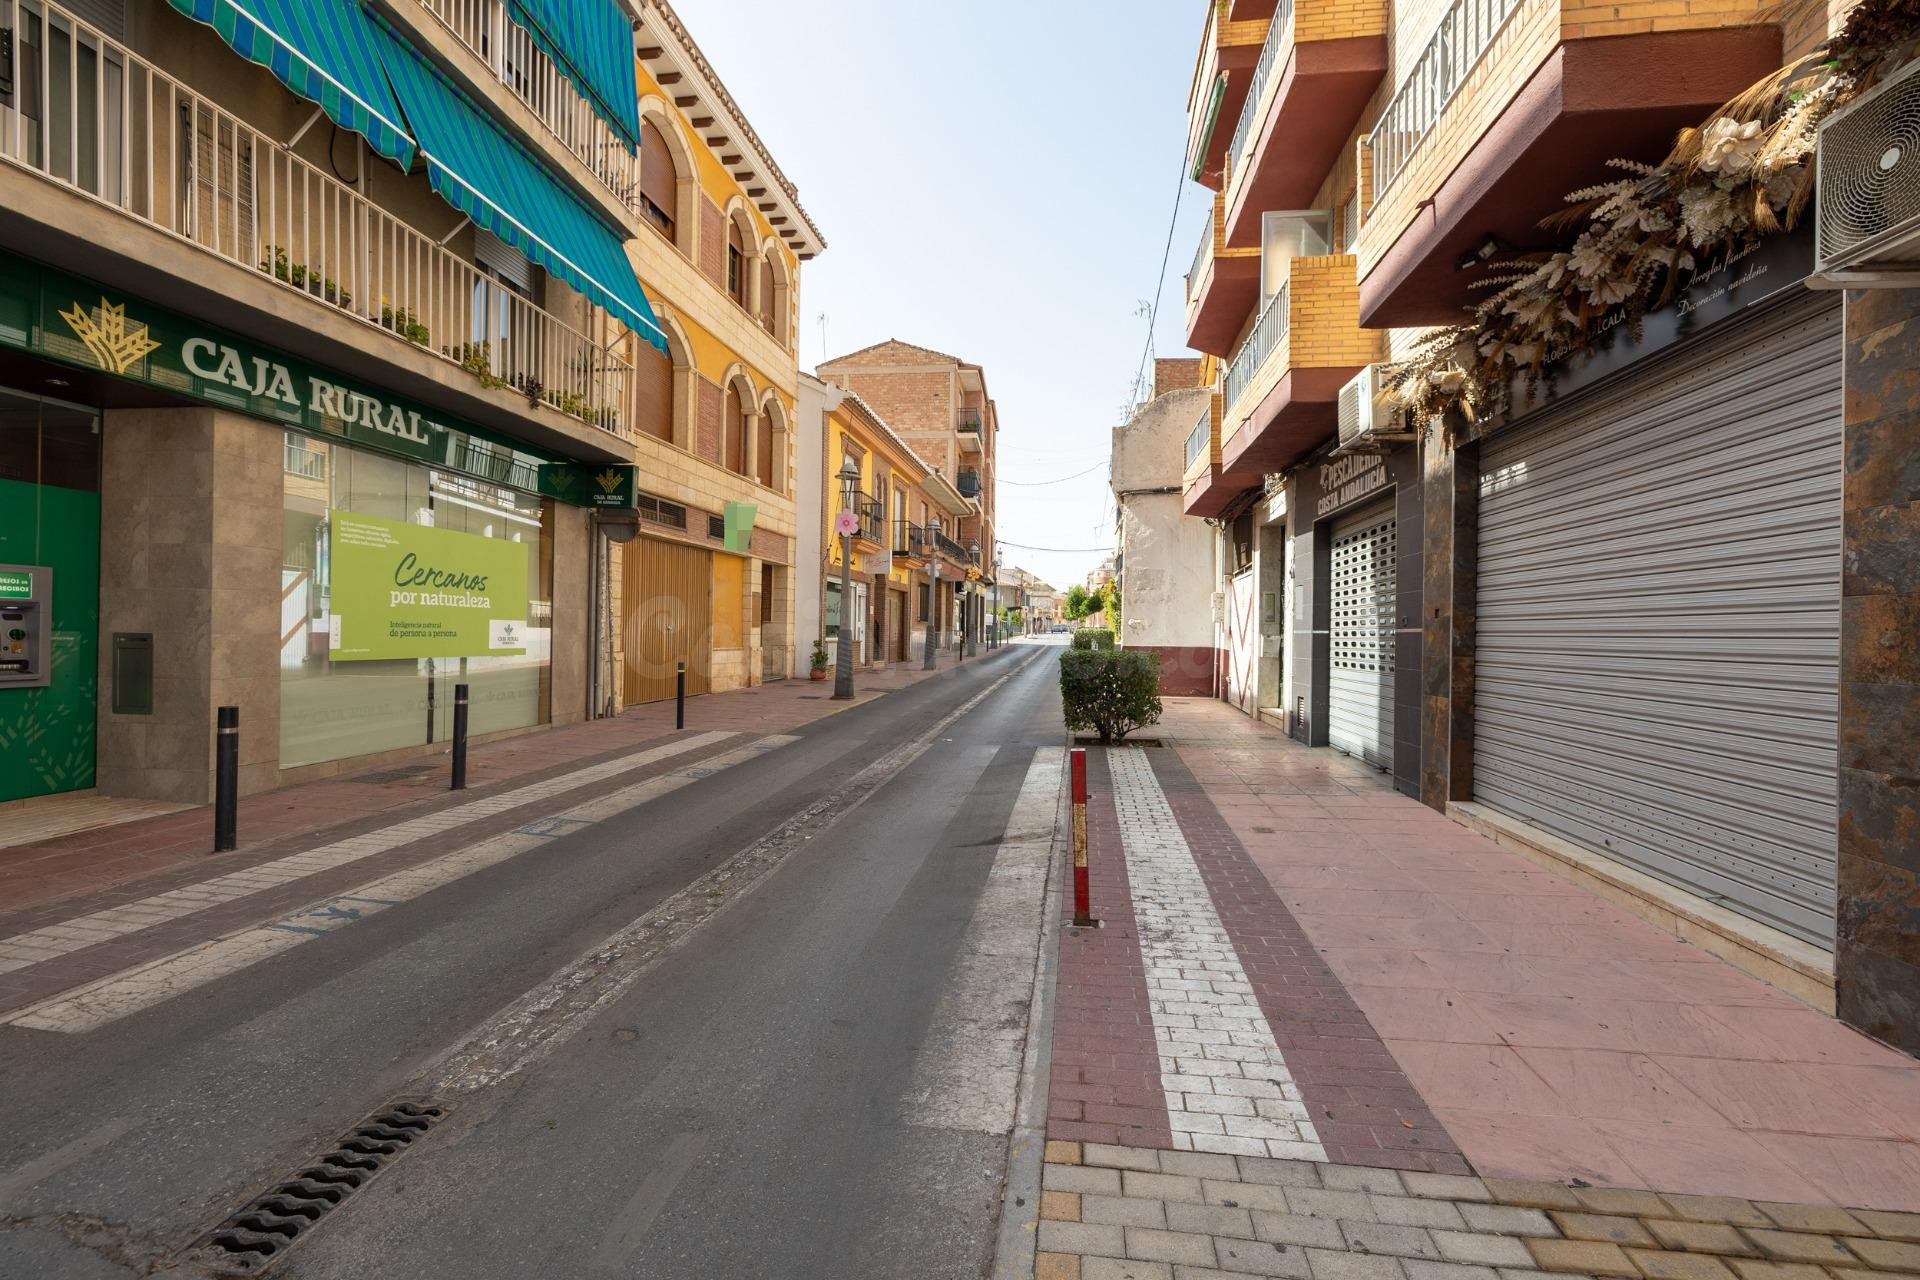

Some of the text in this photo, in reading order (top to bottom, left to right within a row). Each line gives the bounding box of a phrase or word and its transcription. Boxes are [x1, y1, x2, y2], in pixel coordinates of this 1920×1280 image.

[1675, 263, 1768, 318] Decoración navideña
[1680, 255, 1722, 291] Arreglos
[181, 337, 429, 445] CAJA RURAL
[1317, 491, 1339, 515] COSTA
[1340, 465, 1386, 505] ANDALUCÍA
[395, 552, 488, 591] Cercanos
[389, 591, 491, 609] por naturaleza
[389, 621, 422, 629] Inteligencia
[389, 629, 399, 637] de
[400, 630, 426, 638] persona
[433, 631, 457, 639] persona
